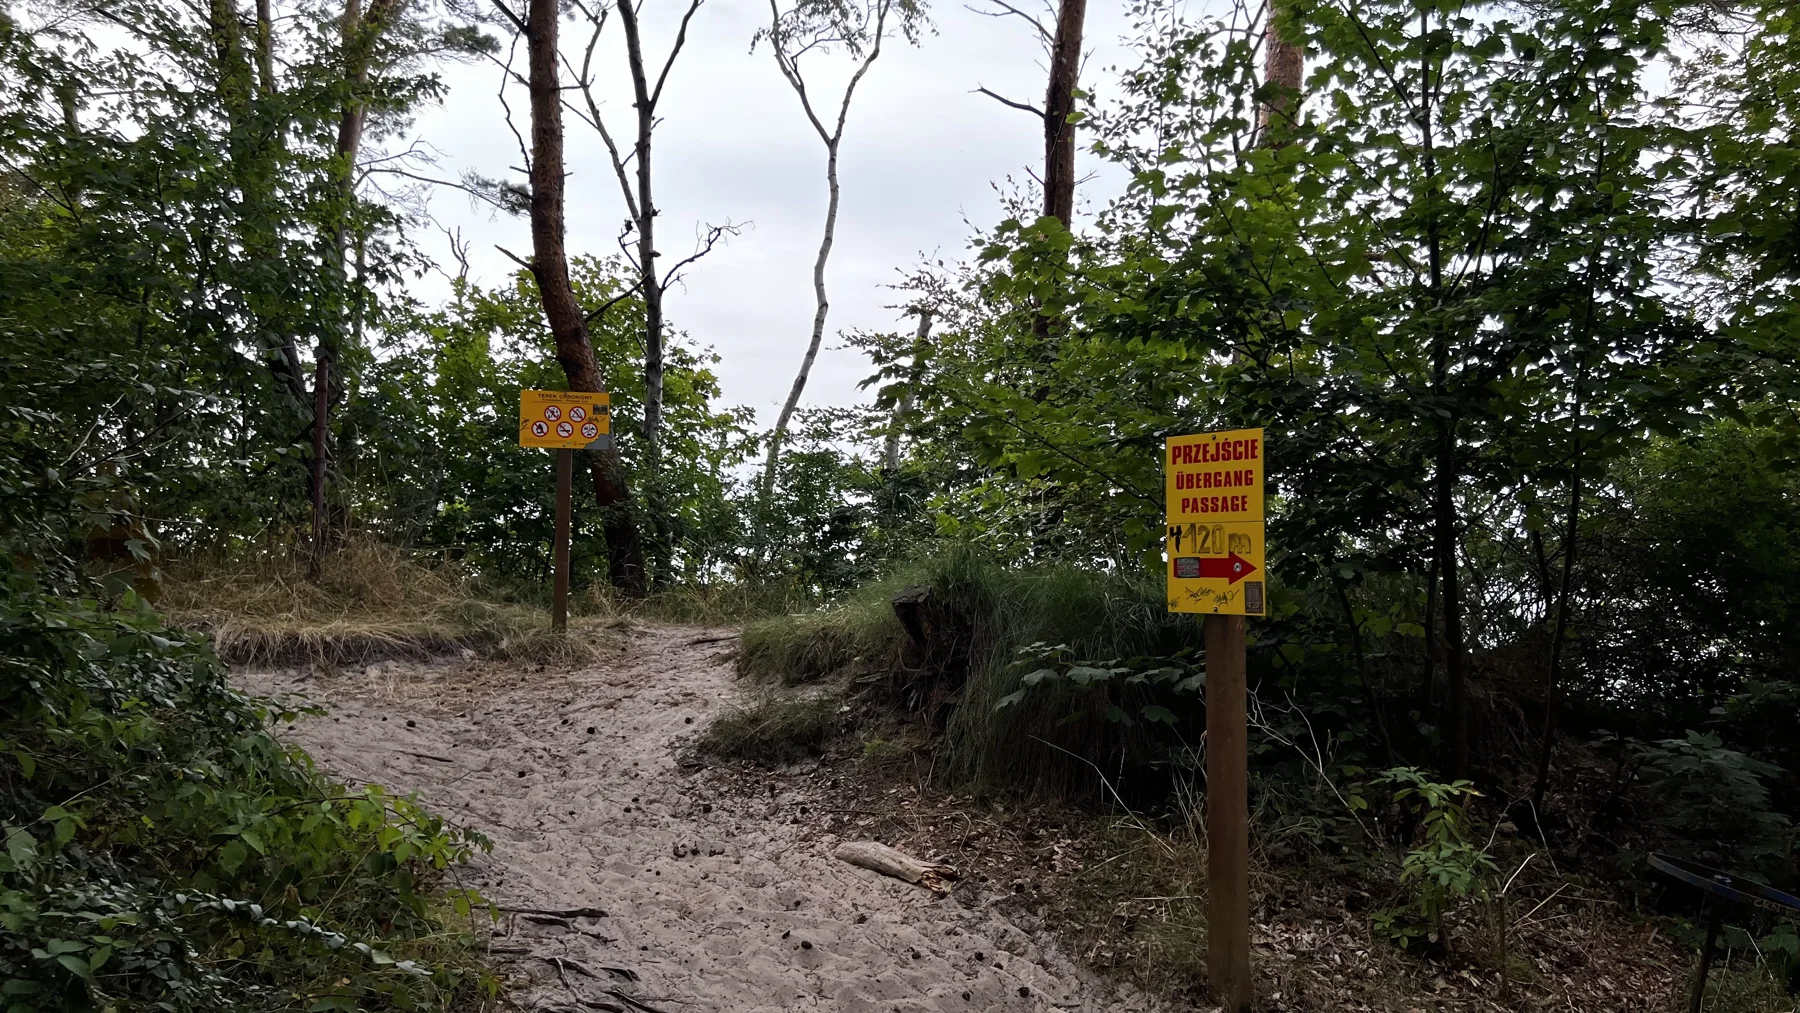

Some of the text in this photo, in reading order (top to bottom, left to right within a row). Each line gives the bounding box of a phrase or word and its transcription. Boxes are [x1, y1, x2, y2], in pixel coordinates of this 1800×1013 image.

[1172, 437, 1258, 465] PRZEJŚCIE
[1176, 469, 1254, 490] ÜBERGANG
[1181, 495, 1248, 514] PASSAGE
